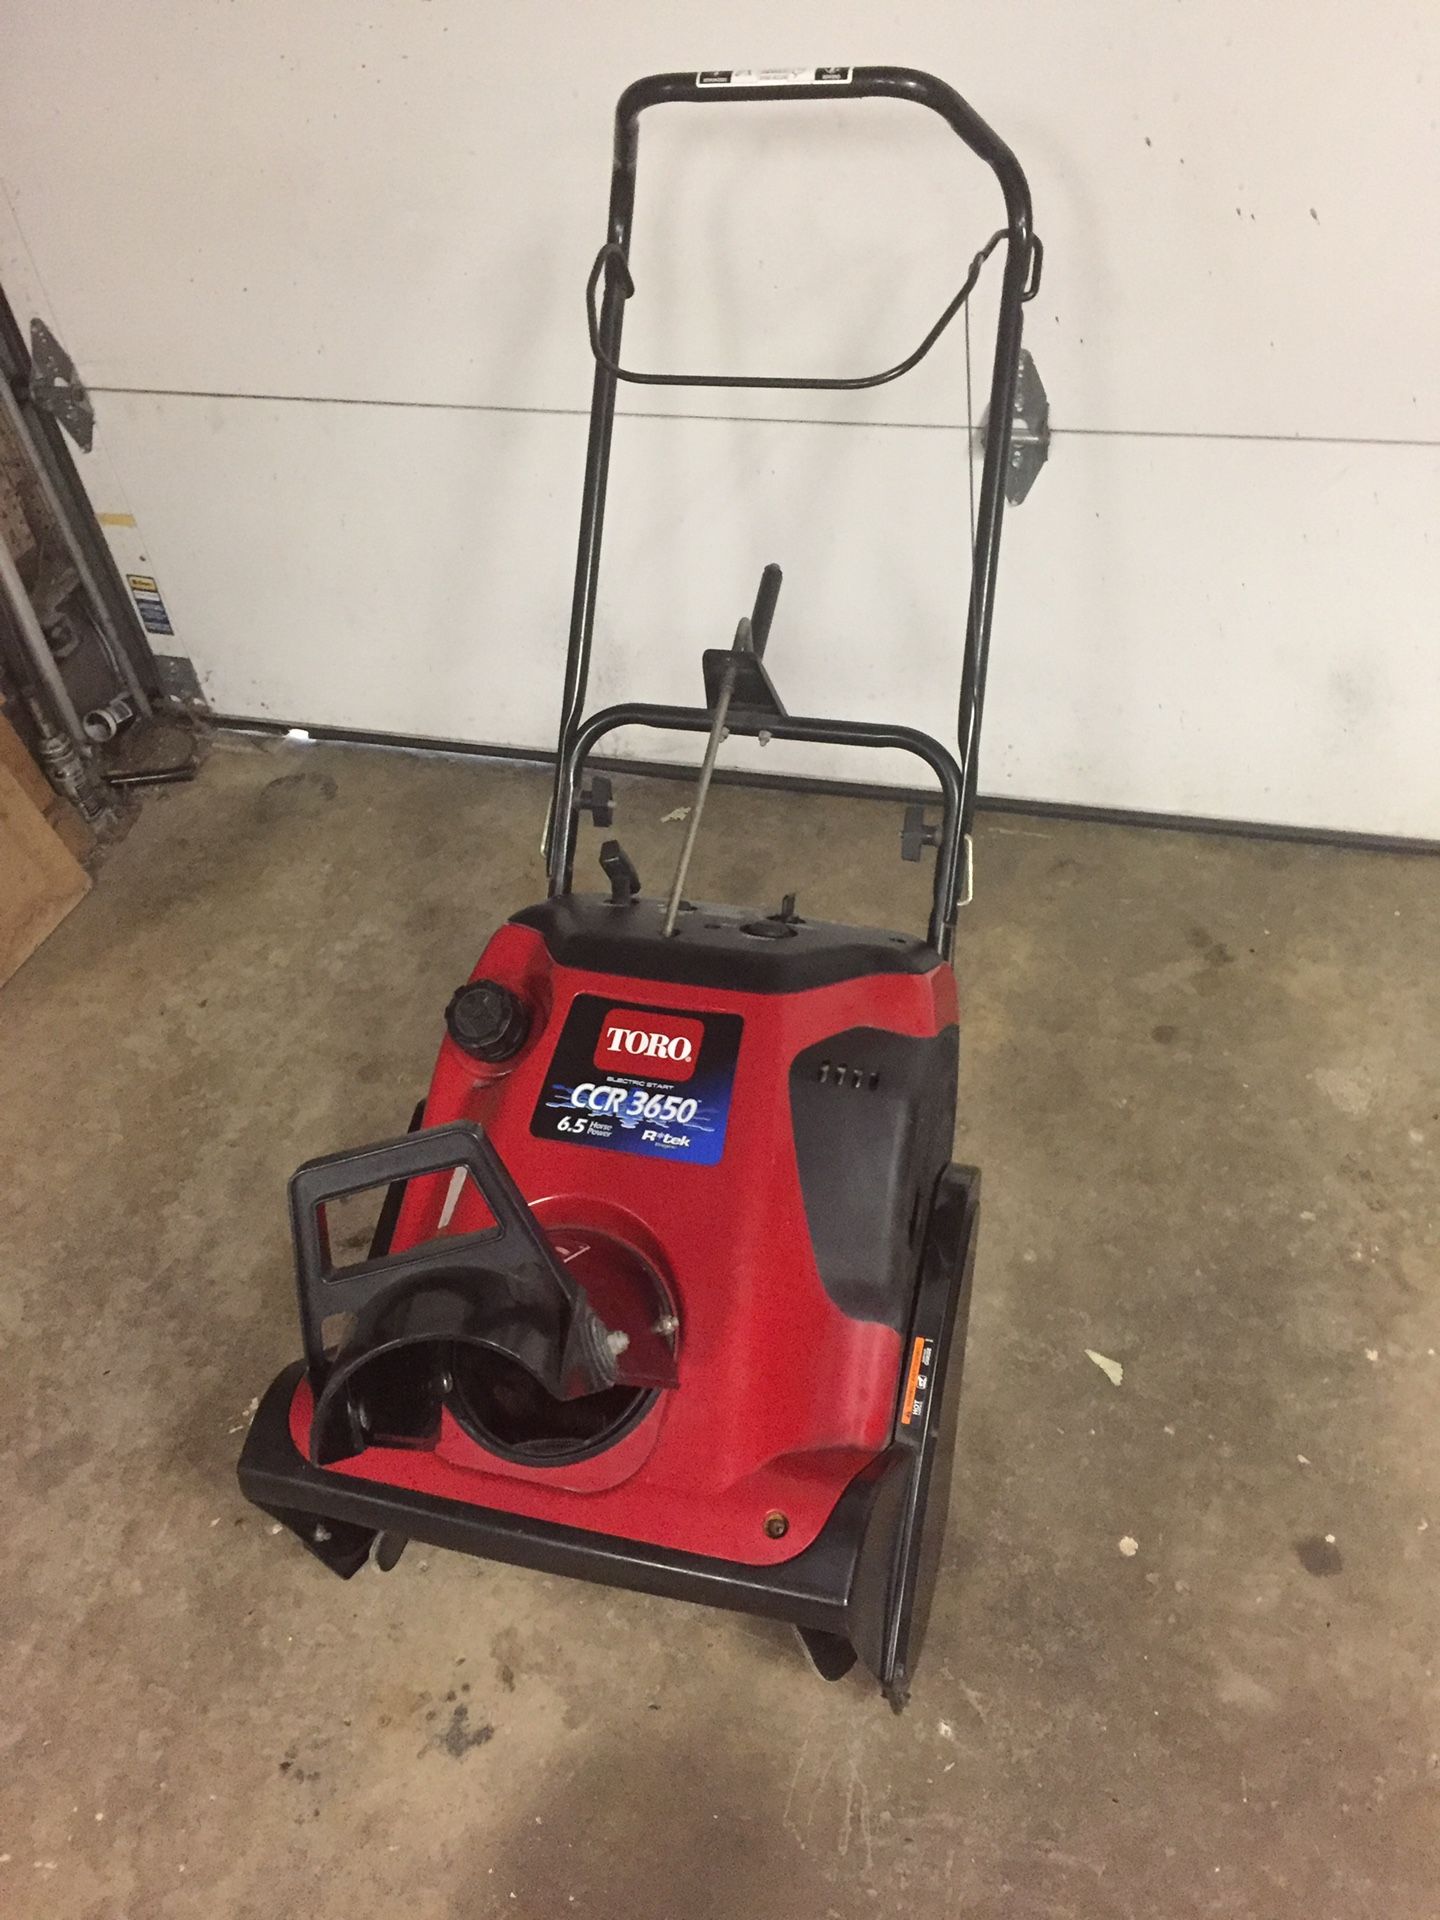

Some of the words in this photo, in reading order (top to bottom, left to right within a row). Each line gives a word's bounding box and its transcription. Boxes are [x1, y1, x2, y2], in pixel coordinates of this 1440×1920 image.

[607, 1027, 692, 1062] TORO
[606, 1076, 645, 1087] ELECTRIC
[646, 1082, 674, 1090] START
[571, 1083, 628, 1113] CCR
[627, 1090, 698, 1124] 3650
[557, 1115, 588, 1133] 6.5
[589, 1120, 613, 1131] Horse
[587, 1128, 613, 1138] Power
